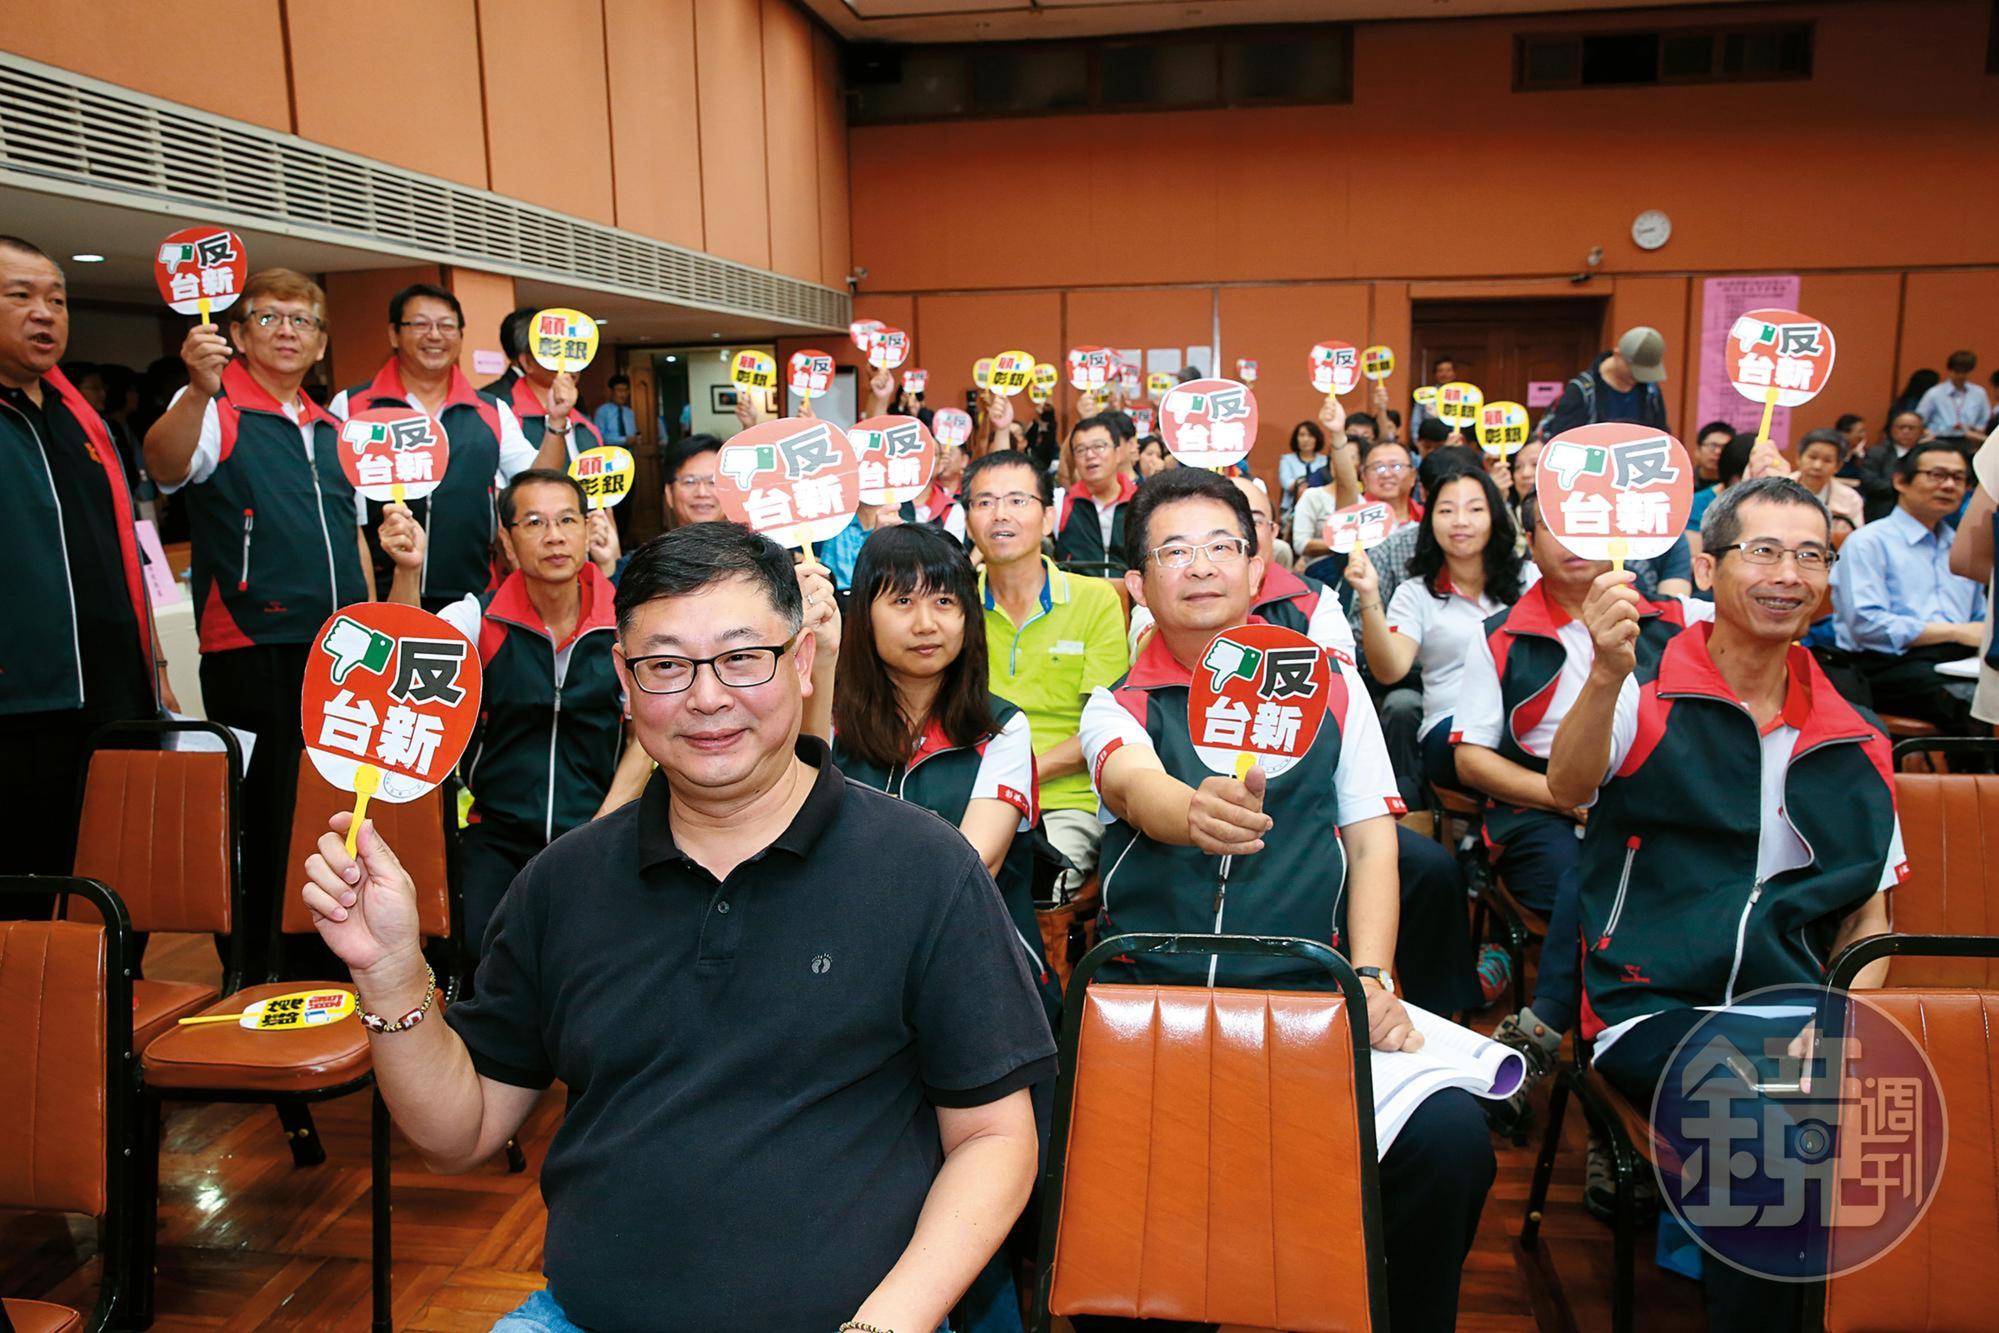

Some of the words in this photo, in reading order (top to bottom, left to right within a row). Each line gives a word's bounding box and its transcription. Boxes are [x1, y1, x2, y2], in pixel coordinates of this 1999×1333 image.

[196, 232, 236, 268] 反
[170, 266, 235, 302] 台新
[539, 315, 567, 336] 願
[1778, 325, 1822, 355] 反
[538, 337, 588, 361] 彰銀
[813, 357, 831, 373] 反
[1335, 349, 1355, 366] 反
[1738, 352, 1815, 391] 台新
[1208, 388, 1248, 420] 反
[389, 417, 435, 451] 反
[779, 425, 842, 478] 反
[885, 423, 923, 457] 反
[356, 452, 434, 485] 台新
[858, 456, 922, 489] 台新
[1612, 438, 1677, 489] 反
[743, 474, 845, 530] 台新
[1360, 504, 1386, 526] 反
[1560, 490, 1671, 535] 台新
[389, 639, 466, 706] 反
[1258, 649, 1318, 699] 反
[318, 689, 446, 776] 台新
[1202, 695, 1304, 753] 台新
